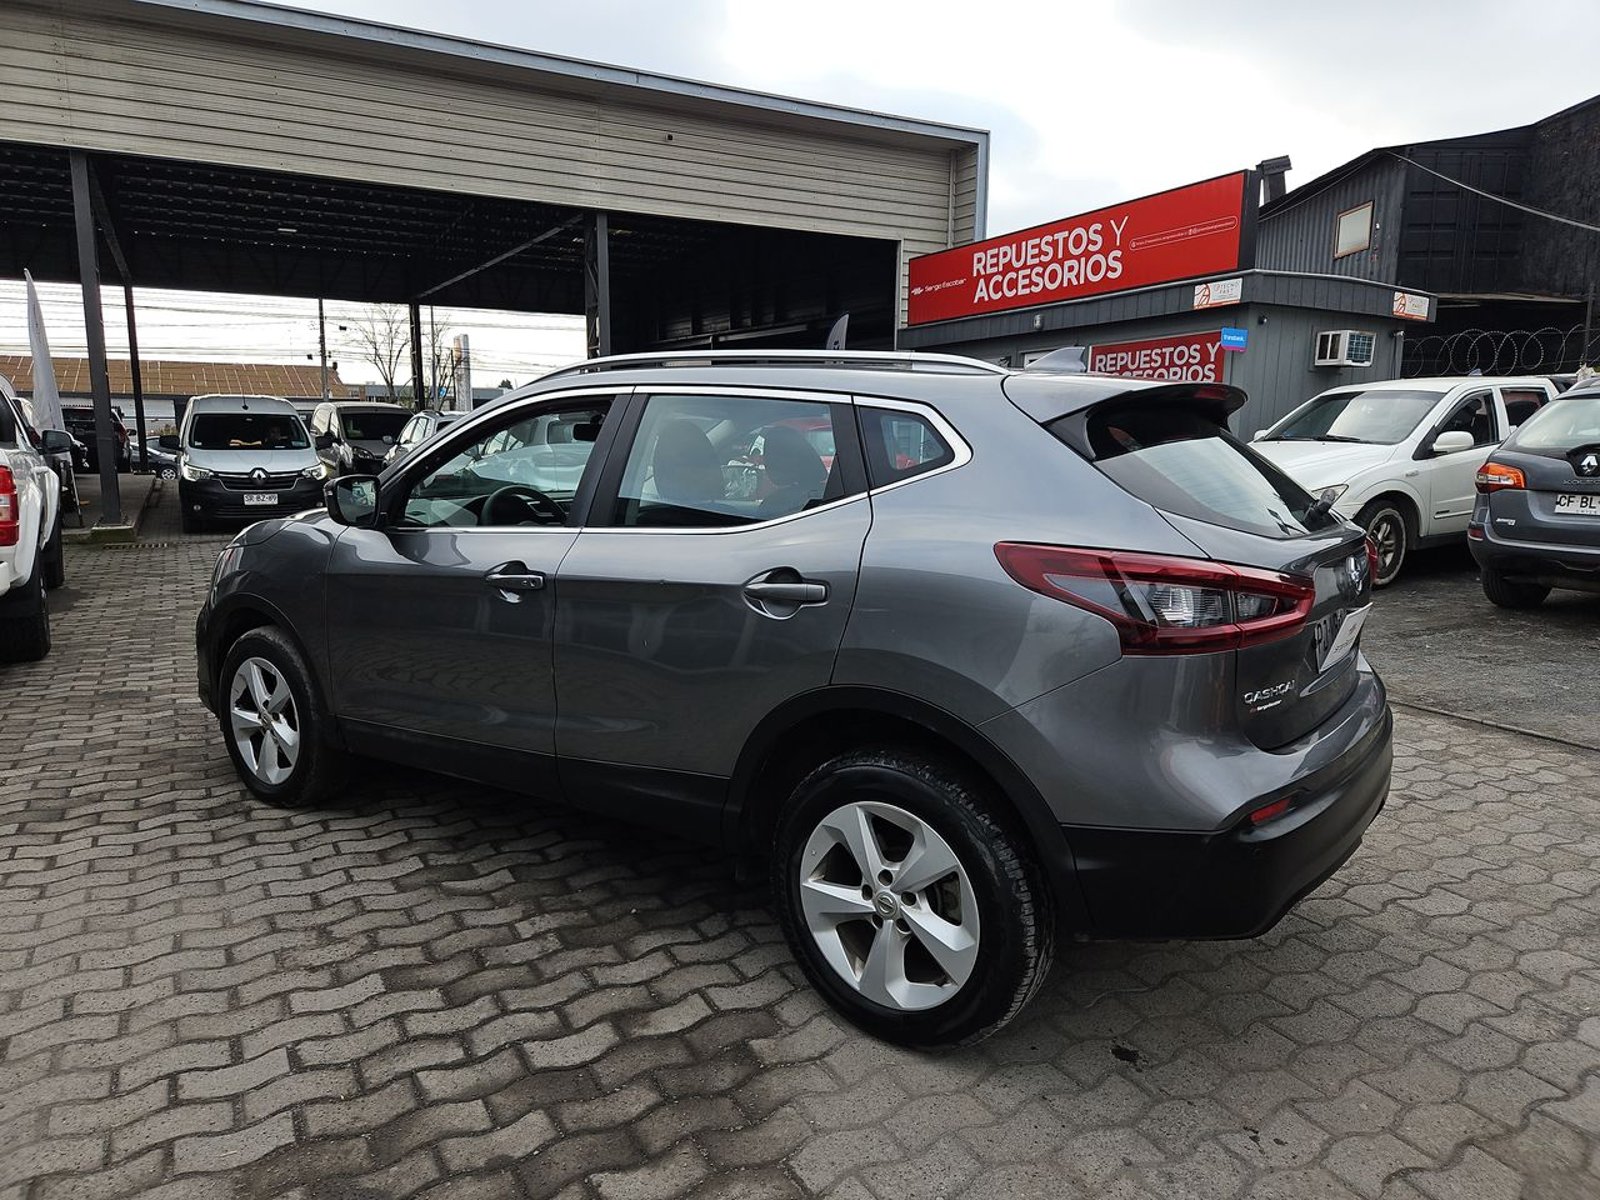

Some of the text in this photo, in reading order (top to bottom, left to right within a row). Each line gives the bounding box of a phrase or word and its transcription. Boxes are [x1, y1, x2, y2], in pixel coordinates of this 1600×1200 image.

[973, 223, 1103, 277] REPUESTOS
[1110, 215, 1129, 246] Y
[973, 249, 1123, 303] ACCESORIOS
[1095, 342, 1221, 373] REPUESTOS Y
